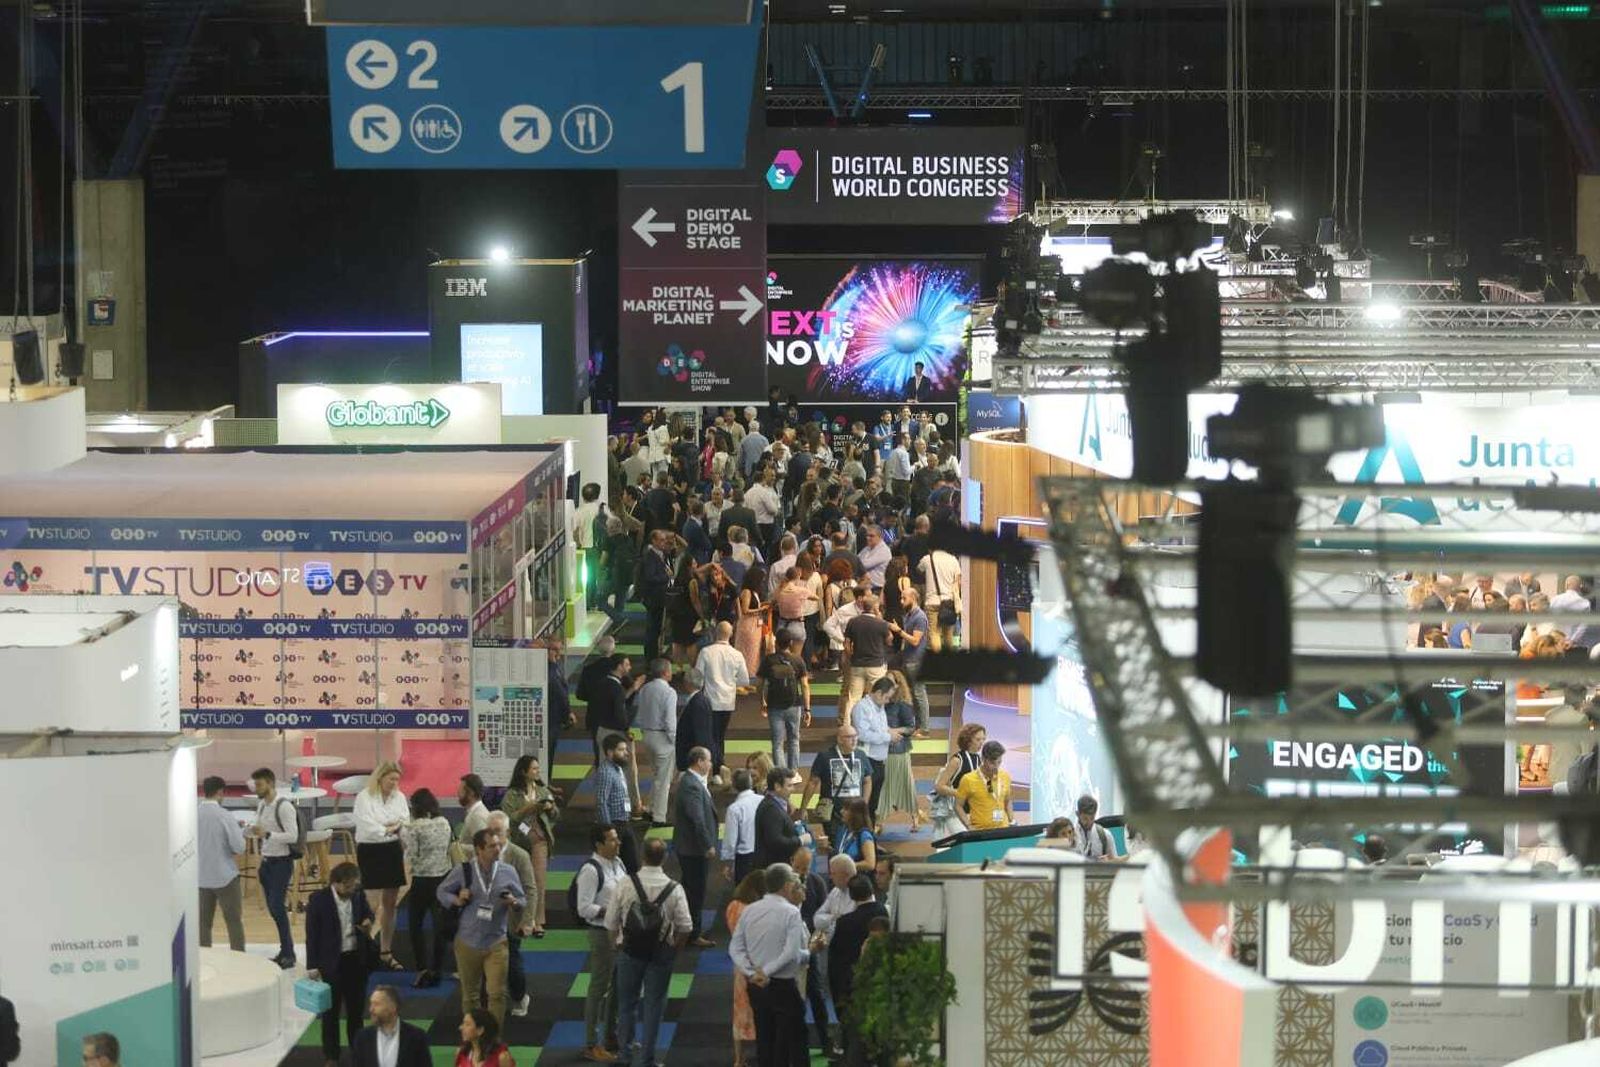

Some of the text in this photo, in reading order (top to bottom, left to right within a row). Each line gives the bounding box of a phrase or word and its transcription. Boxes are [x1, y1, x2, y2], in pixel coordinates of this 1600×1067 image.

[407, 40, 439, 89] 2
[660, 62, 705, 153] 1
[831, 156, 1009, 175] DIGITAL BUSINESS
[775, 168, 787, 184] S
[832, 178, 1009, 197] WORLD CONGRESS
[686, 208, 752, 221] DIGITAL
[686, 223, 735, 235] DEMO
[686, 237, 741, 249] STAGE
[445, 278, 487, 296] IBM
[652, 286, 714, 298] DIGITAL
[623, 300, 714, 312] MARKETING
[653, 313, 714, 325] PLANET
[767, 311, 837, 335] EXT
[766, 340, 849, 365] NOW
[326, 400, 431, 427] Globant
[1106, 400, 1133, 440] Junt
[1458, 434, 1574, 468] Junta
[28, 528, 91, 540] TVSTUDIO
[147, 530, 159, 538] TV
[179, 529, 242, 541] TVSTUDIO
[299, 532, 311, 540] TV
[330, 530, 393, 542] TVSTUDIO
[450, 532, 463, 541] TV
[84, 566, 282, 597] TVSTUDIO
[399, 575, 428, 590] TV
[181, 623, 243, 634] TVSTUDIO
[331, 623, 394, 634] TVSTUDIO
[181, 713, 244, 724] TVSTUDIO
[301, 715, 312, 723] TV
[333, 713, 395, 725] TVSTUDIO
[451, 715, 463, 723] TV
[1272, 740, 1424, 773] ENGAGED
[50, 939, 123, 951] minsait.com
